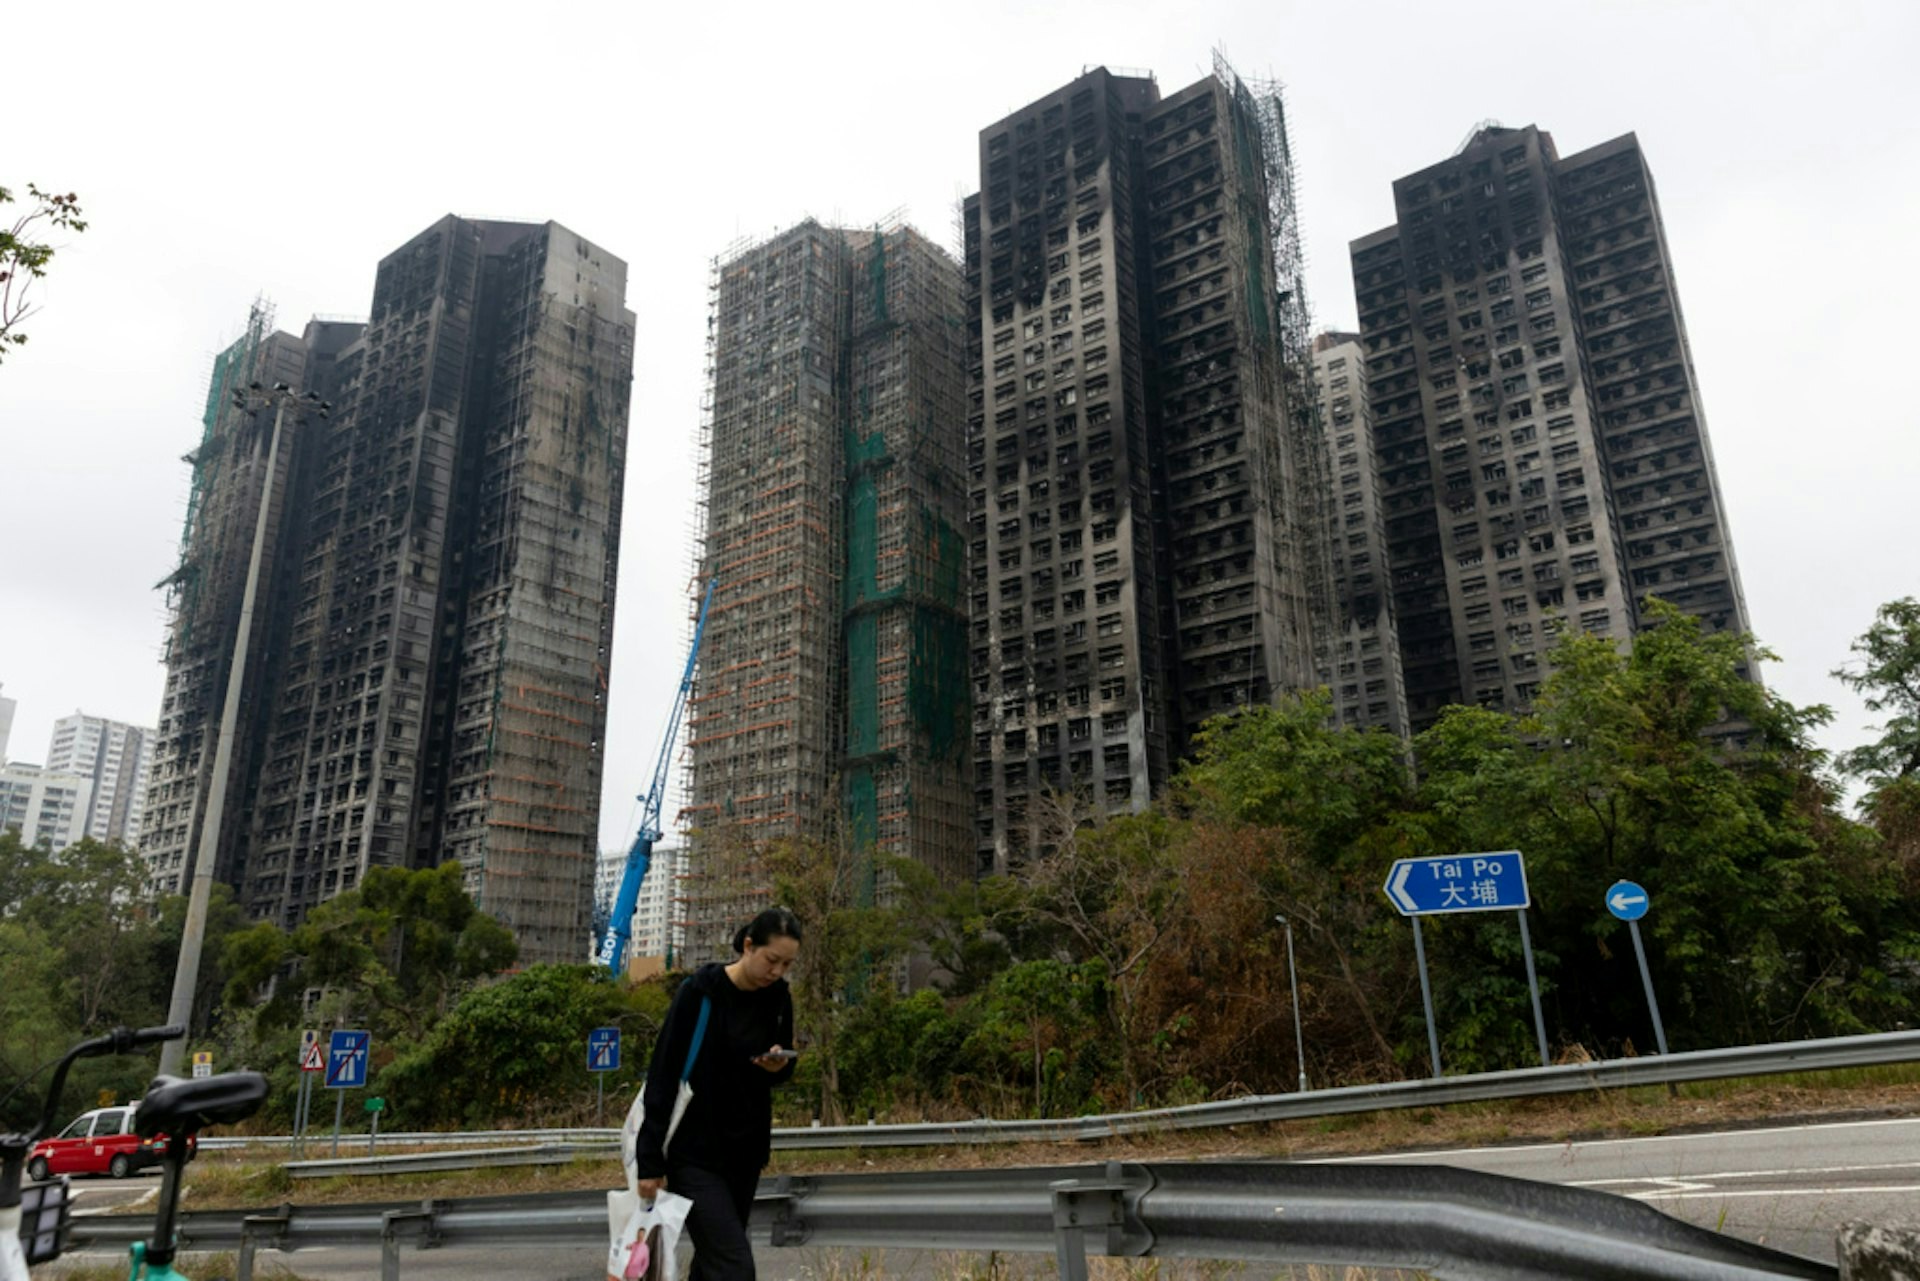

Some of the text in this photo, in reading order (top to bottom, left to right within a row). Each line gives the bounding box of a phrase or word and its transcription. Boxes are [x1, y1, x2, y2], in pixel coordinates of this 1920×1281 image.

[1428, 859, 1503, 879] Tai Po
[1440, 879, 1499, 907] 大埔
